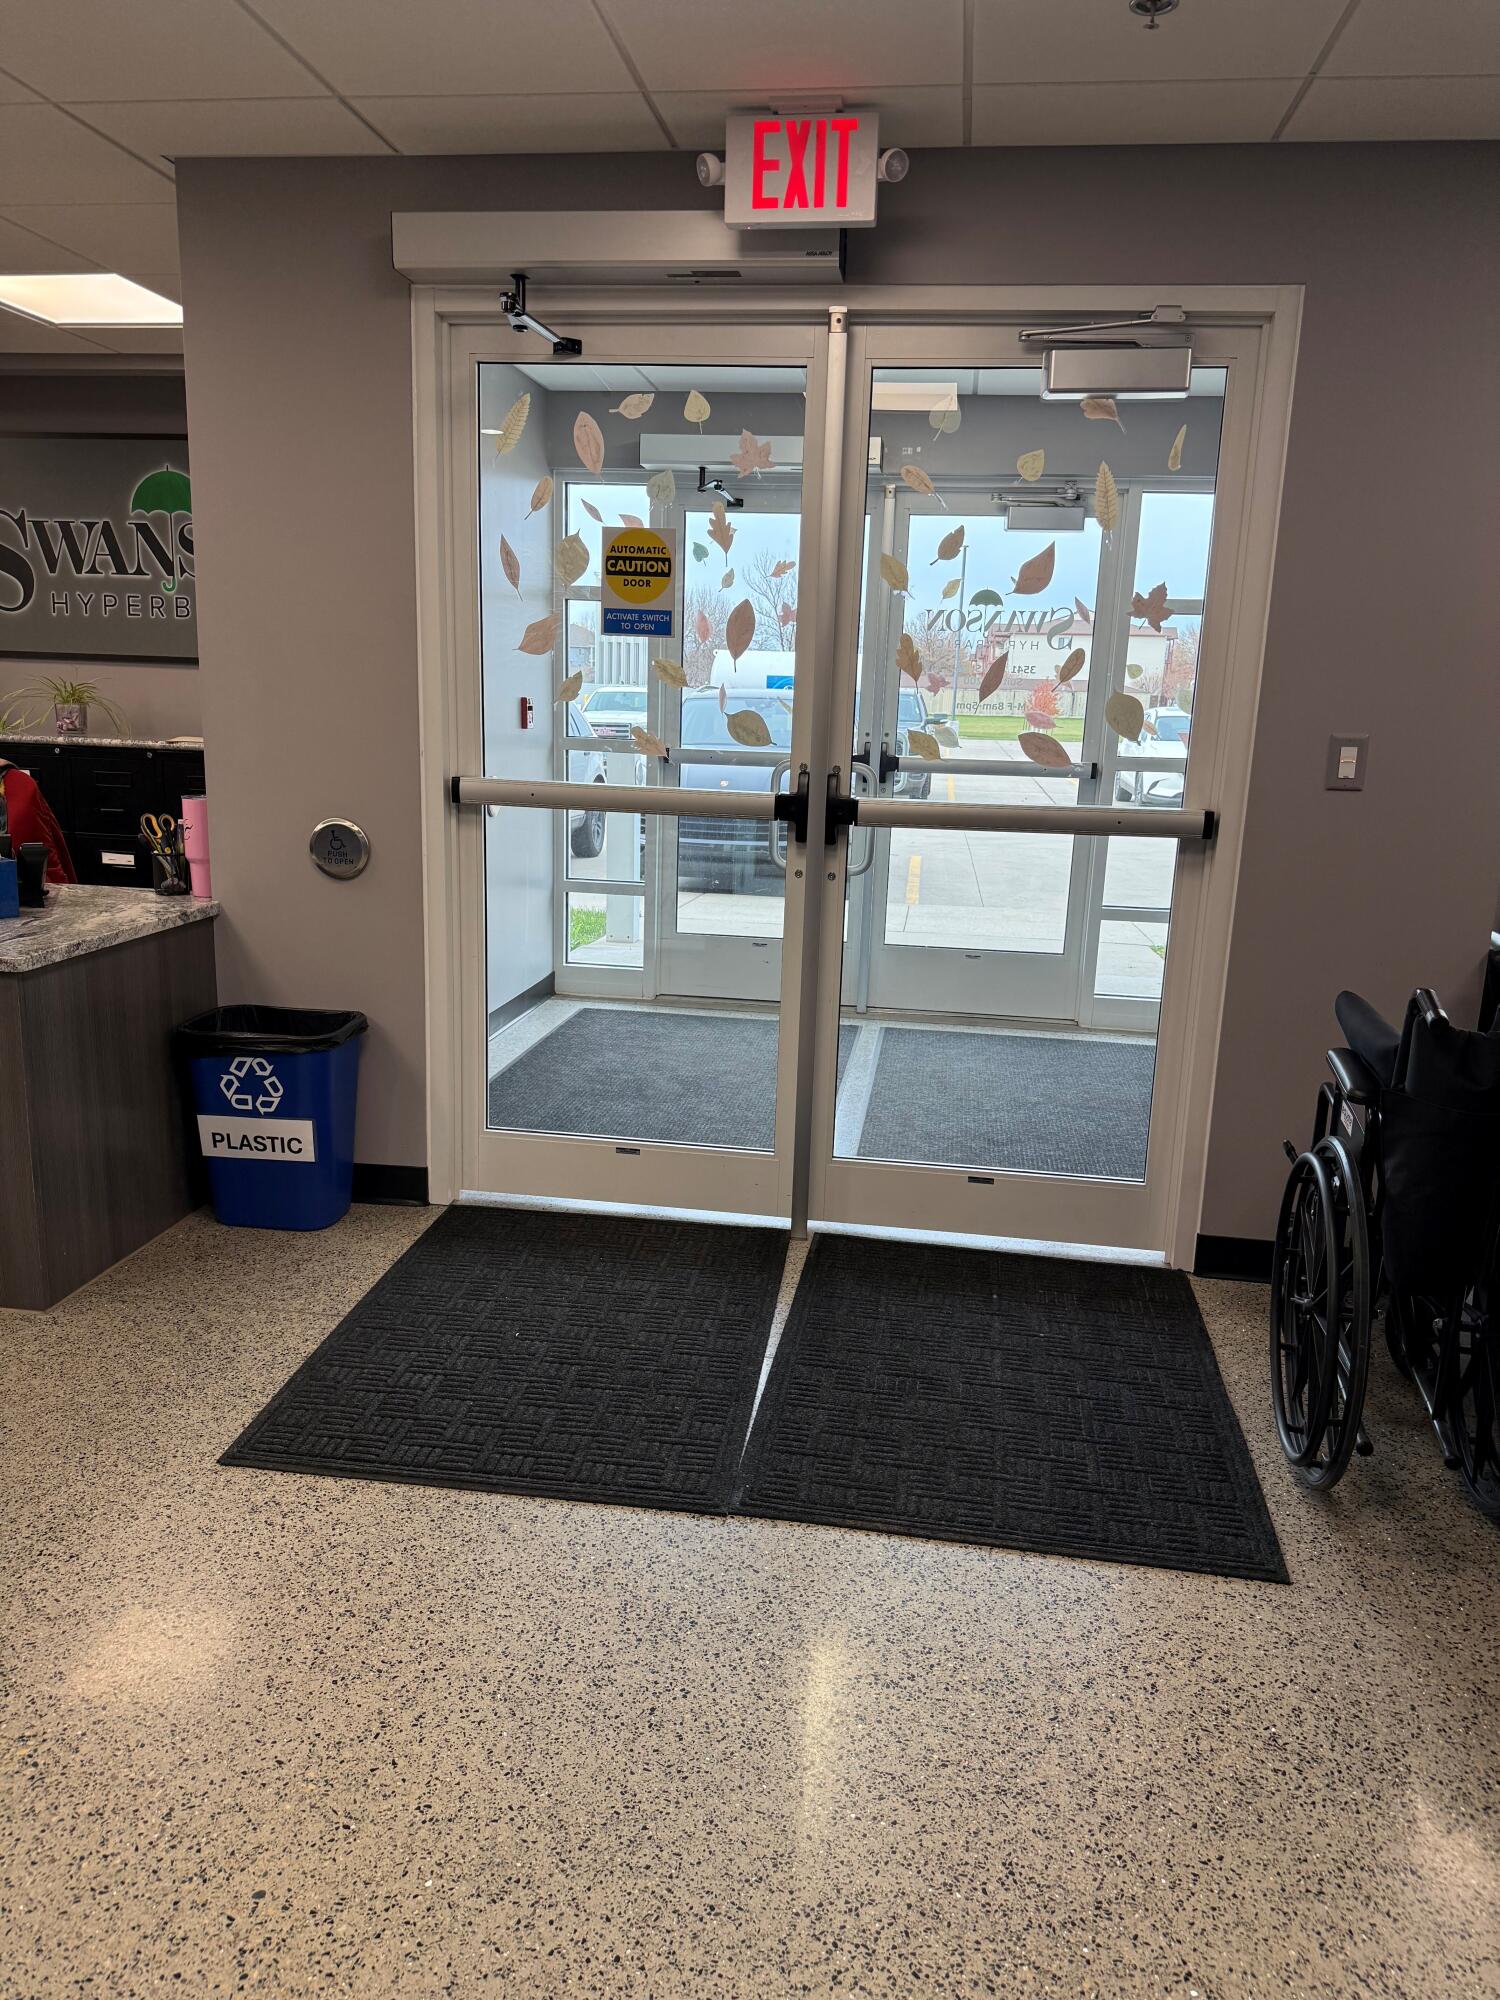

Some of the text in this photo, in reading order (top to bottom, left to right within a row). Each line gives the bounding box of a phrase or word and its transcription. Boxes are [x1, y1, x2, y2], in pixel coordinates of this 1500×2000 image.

[752, 118, 859, 209] EXIT
[610, 545, 667, 555] AUTOMATIC
[607, 559, 669, 574] CAUTION
[623, 579, 652, 588] DOOR
[51, 592, 191, 619] HYPERB
[606, 612, 670, 622] ACTIVATE SWITCH
[621, 622, 655, 631] TO OPEN
[334, 857, 354, 865] OPEN
[211, 1131, 303, 1155] PLASTIC
